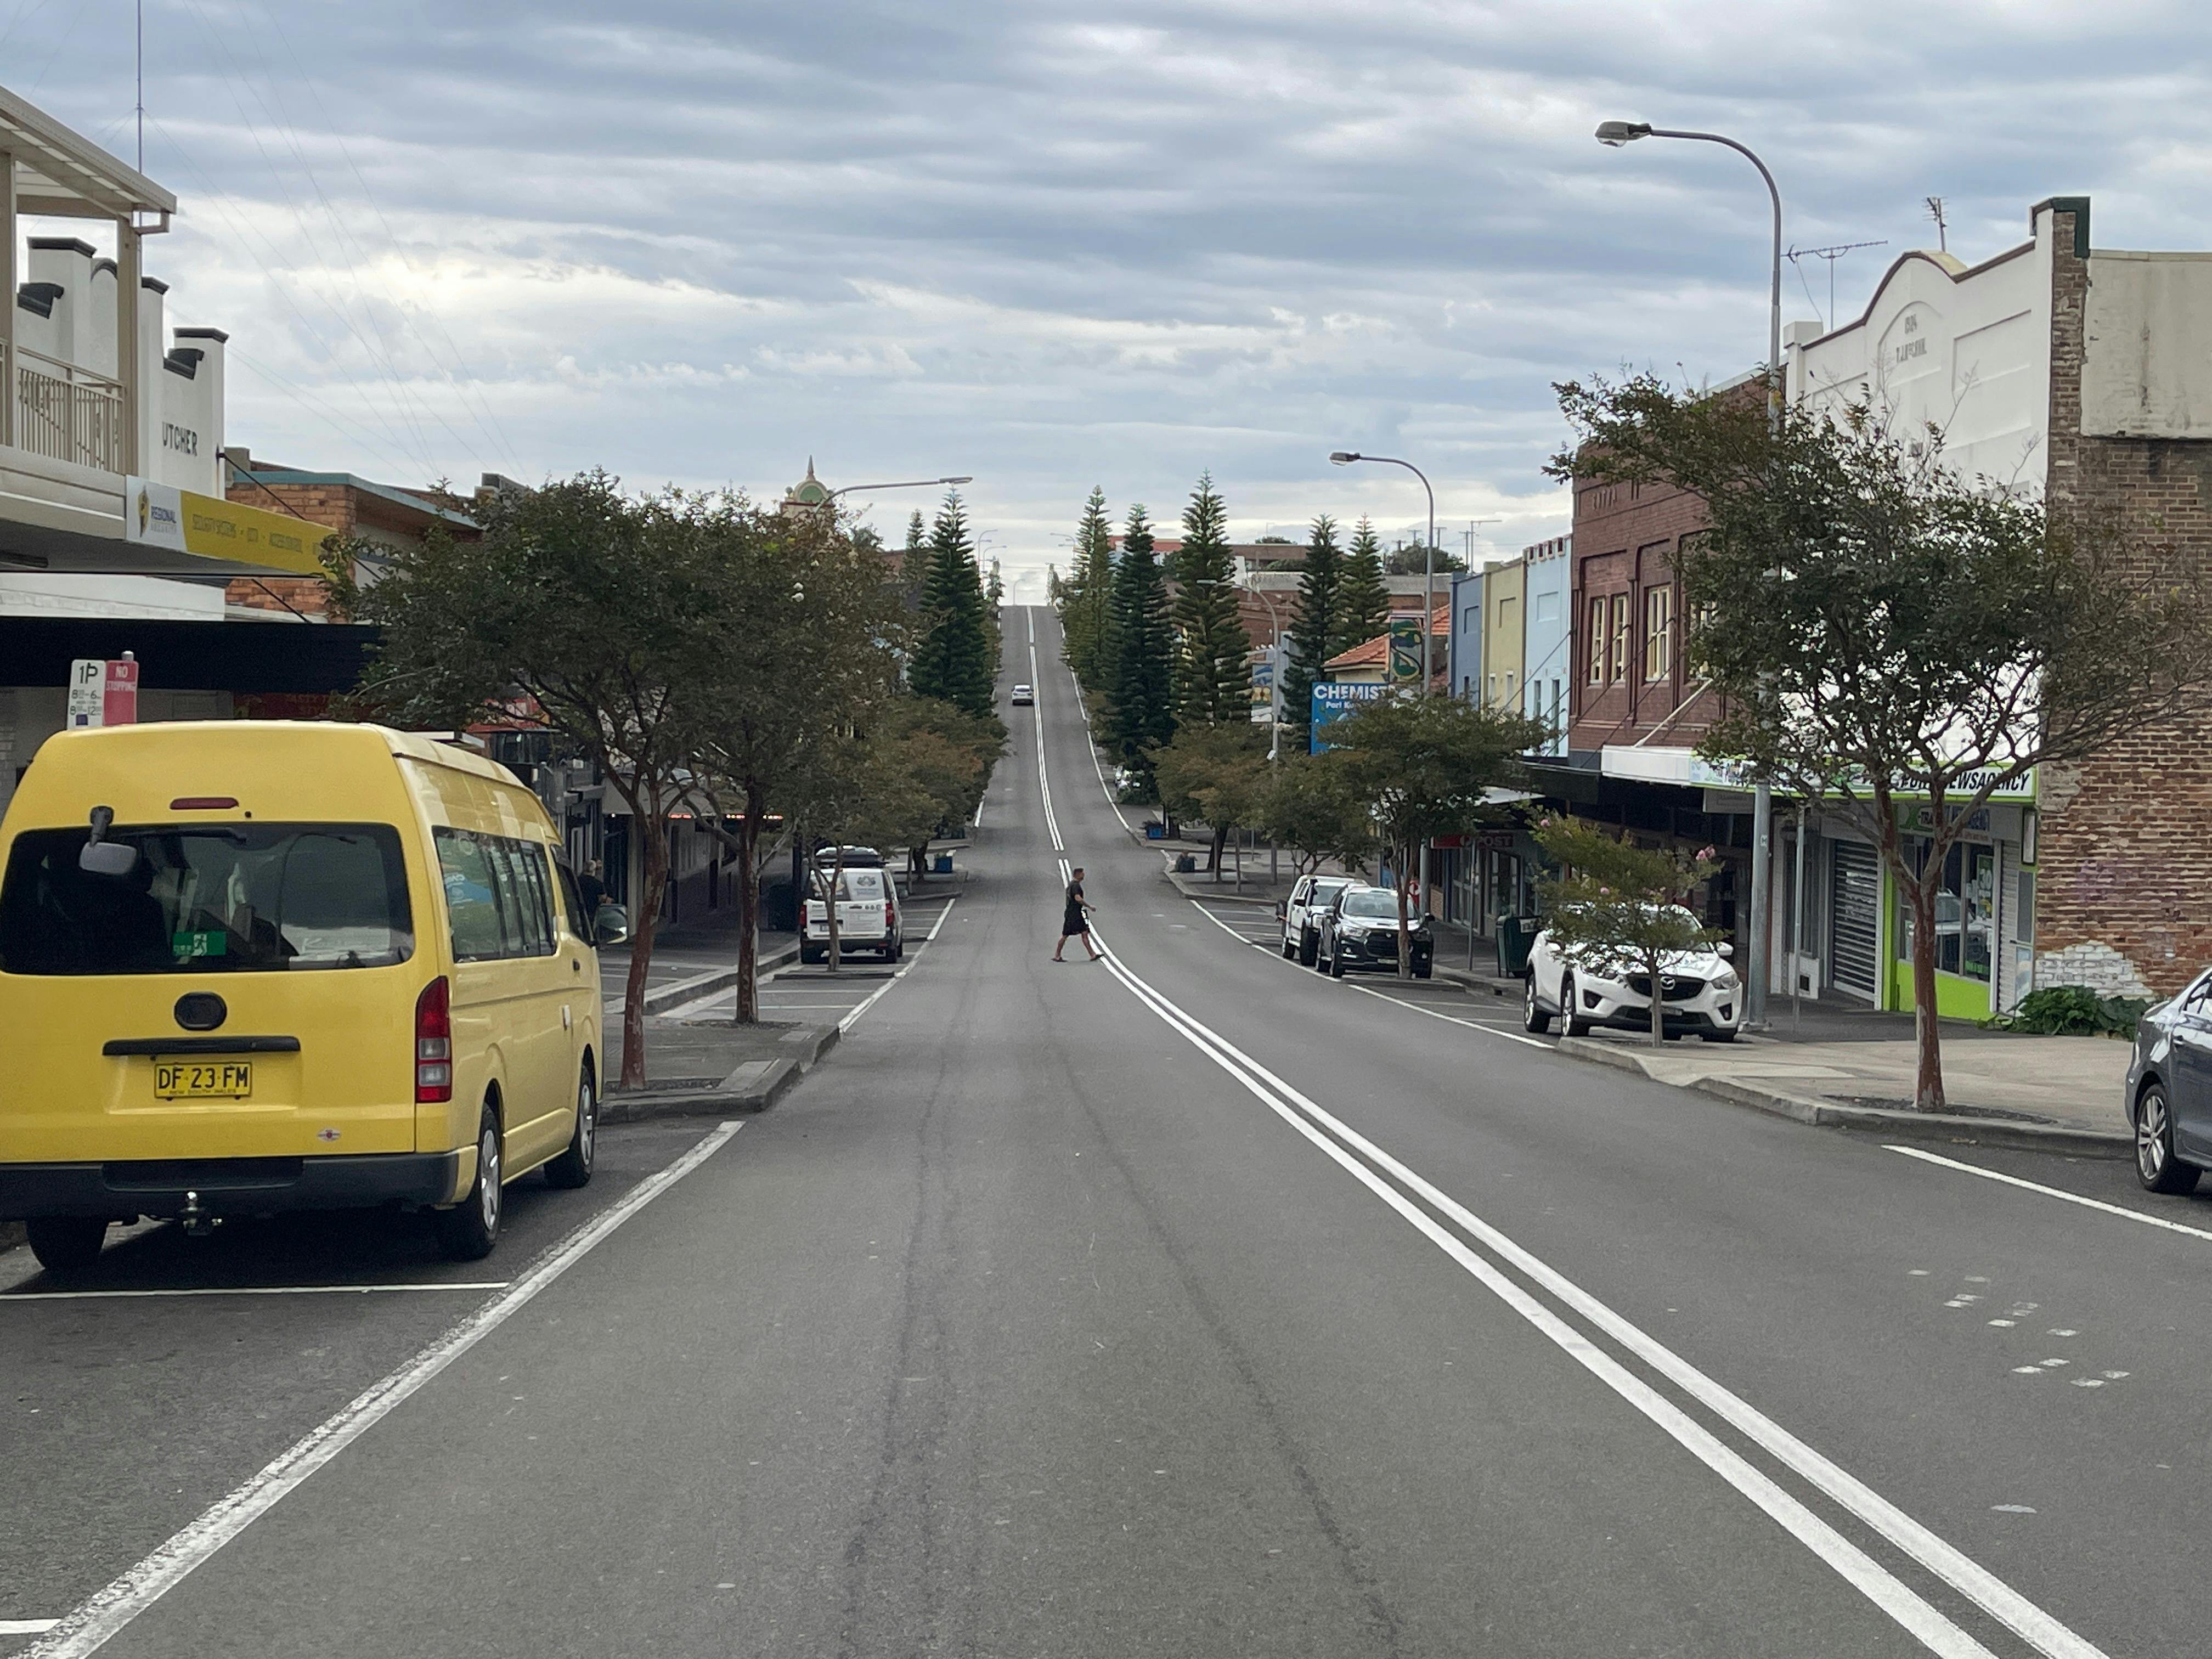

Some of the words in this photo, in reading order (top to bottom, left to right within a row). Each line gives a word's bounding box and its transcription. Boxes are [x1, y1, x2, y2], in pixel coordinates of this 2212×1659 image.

[162, 421, 198, 457] UTCHER
[115, 665, 128, 679] NO
[159, 1068, 184, 1089] DF
[191, 1067, 216, 1088] 23
[223, 1066, 249, 1088] FM
